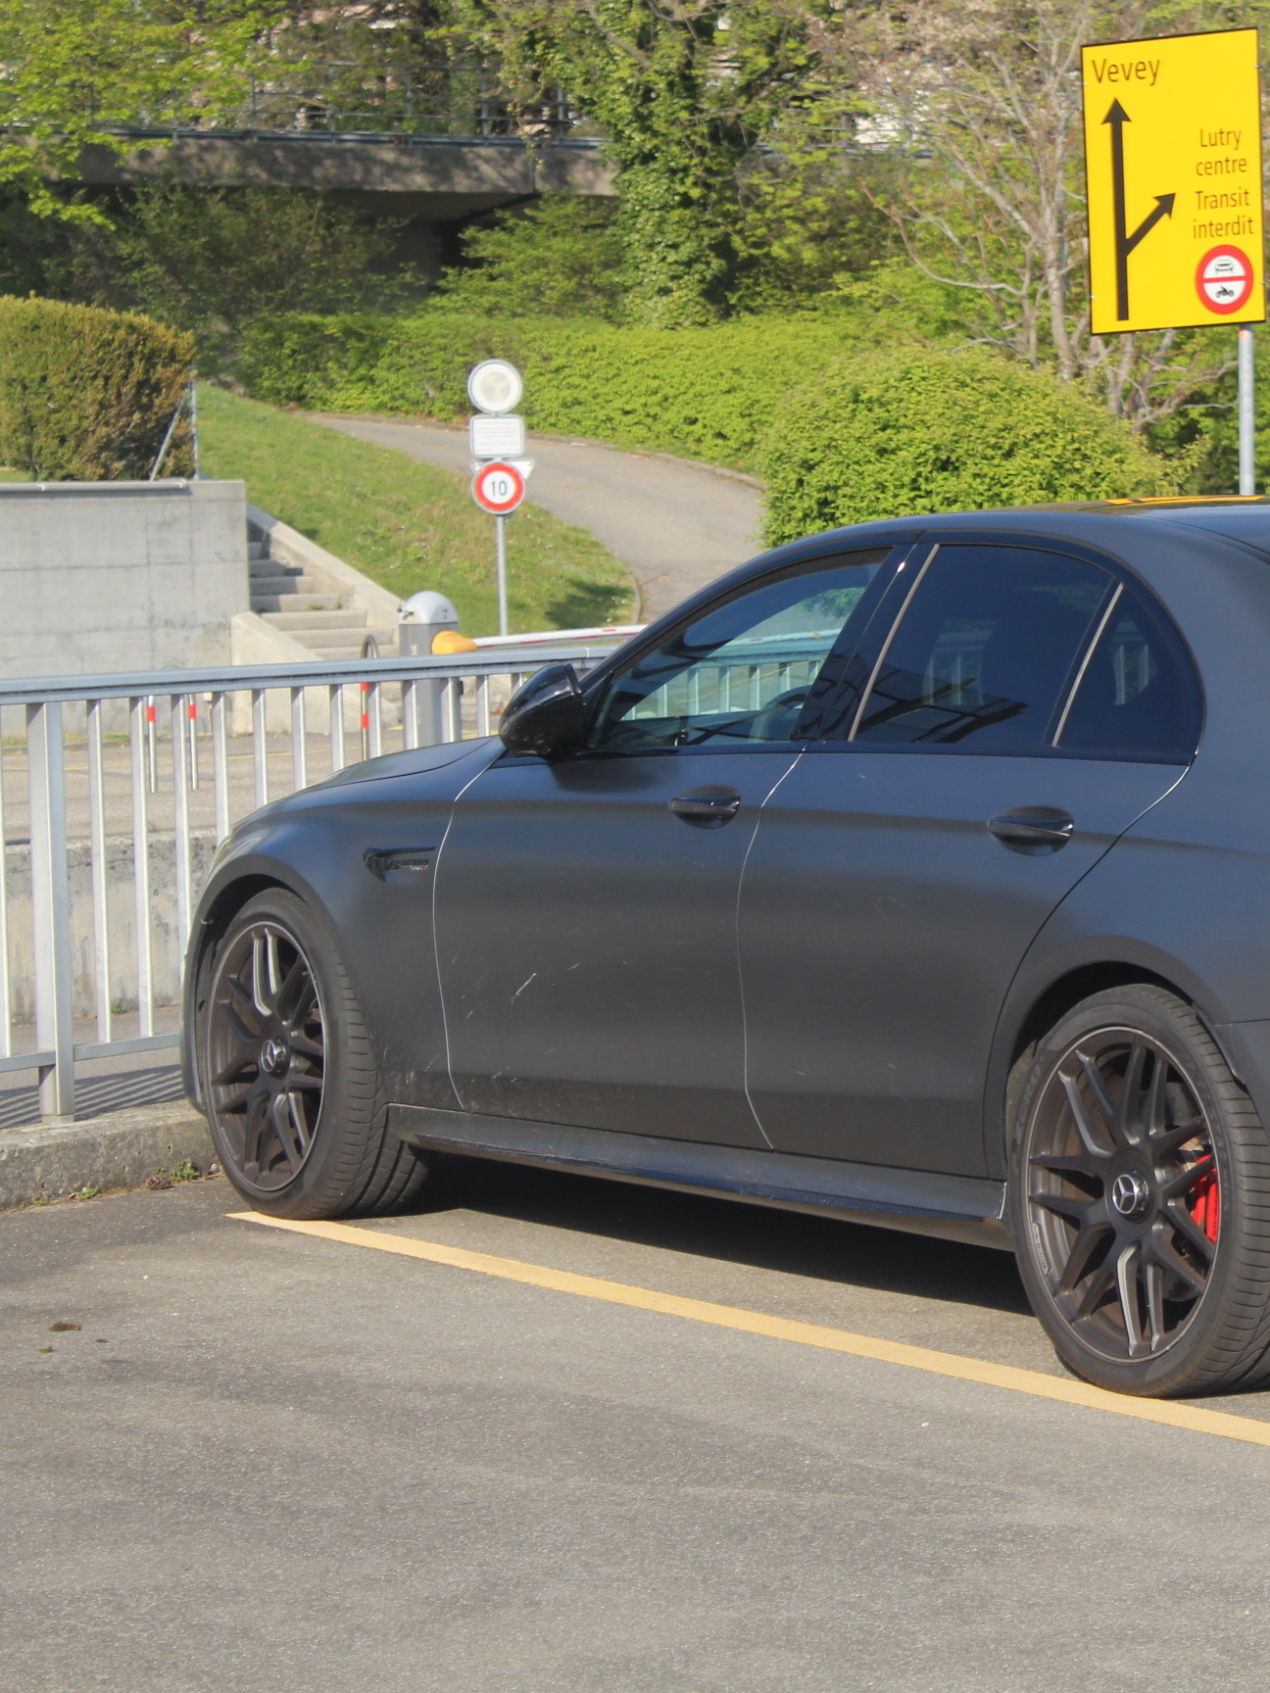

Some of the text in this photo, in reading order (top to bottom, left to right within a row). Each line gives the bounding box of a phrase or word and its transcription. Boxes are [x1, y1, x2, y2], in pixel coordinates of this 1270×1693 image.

[1091, 58, 1161, 87] Vevey
[1199, 128, 1243, 151] Lutry
[1195, 156, 1248, 177] centre
[1194, 187, 1251, 211] Transit
[1192, 215, 1255, 240] interdit
[490, 480, 508, 497] 10
